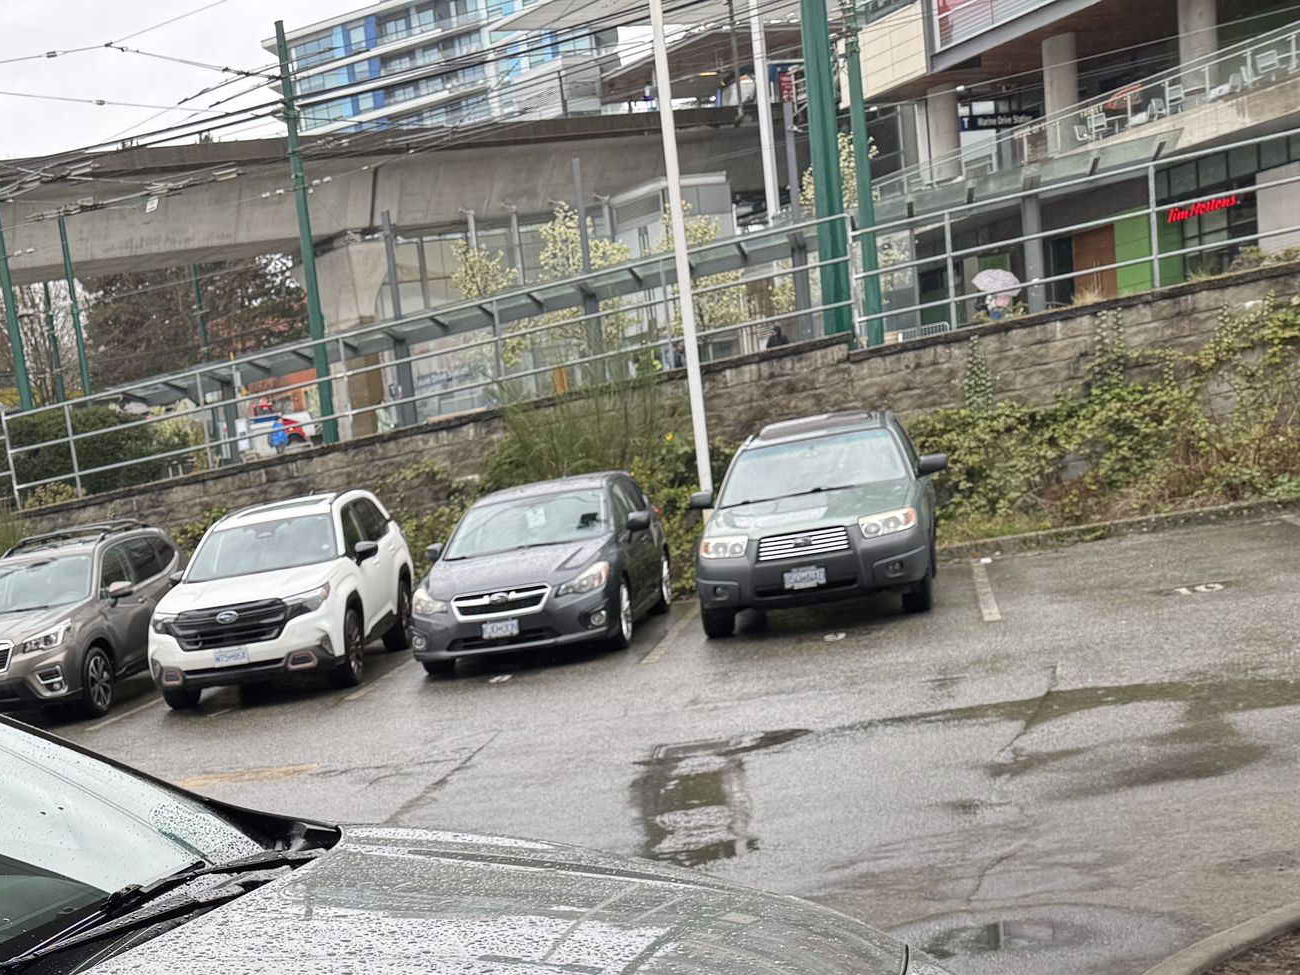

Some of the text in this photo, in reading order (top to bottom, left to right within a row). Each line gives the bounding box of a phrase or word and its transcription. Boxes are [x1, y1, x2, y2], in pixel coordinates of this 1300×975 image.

[977, 115, 997, 127] Marine
[997, 115, 1012, 125] Drive
[1012, 113, 1033, 124] Station
[1167, 195, 1237, 224] Tim Hortons
